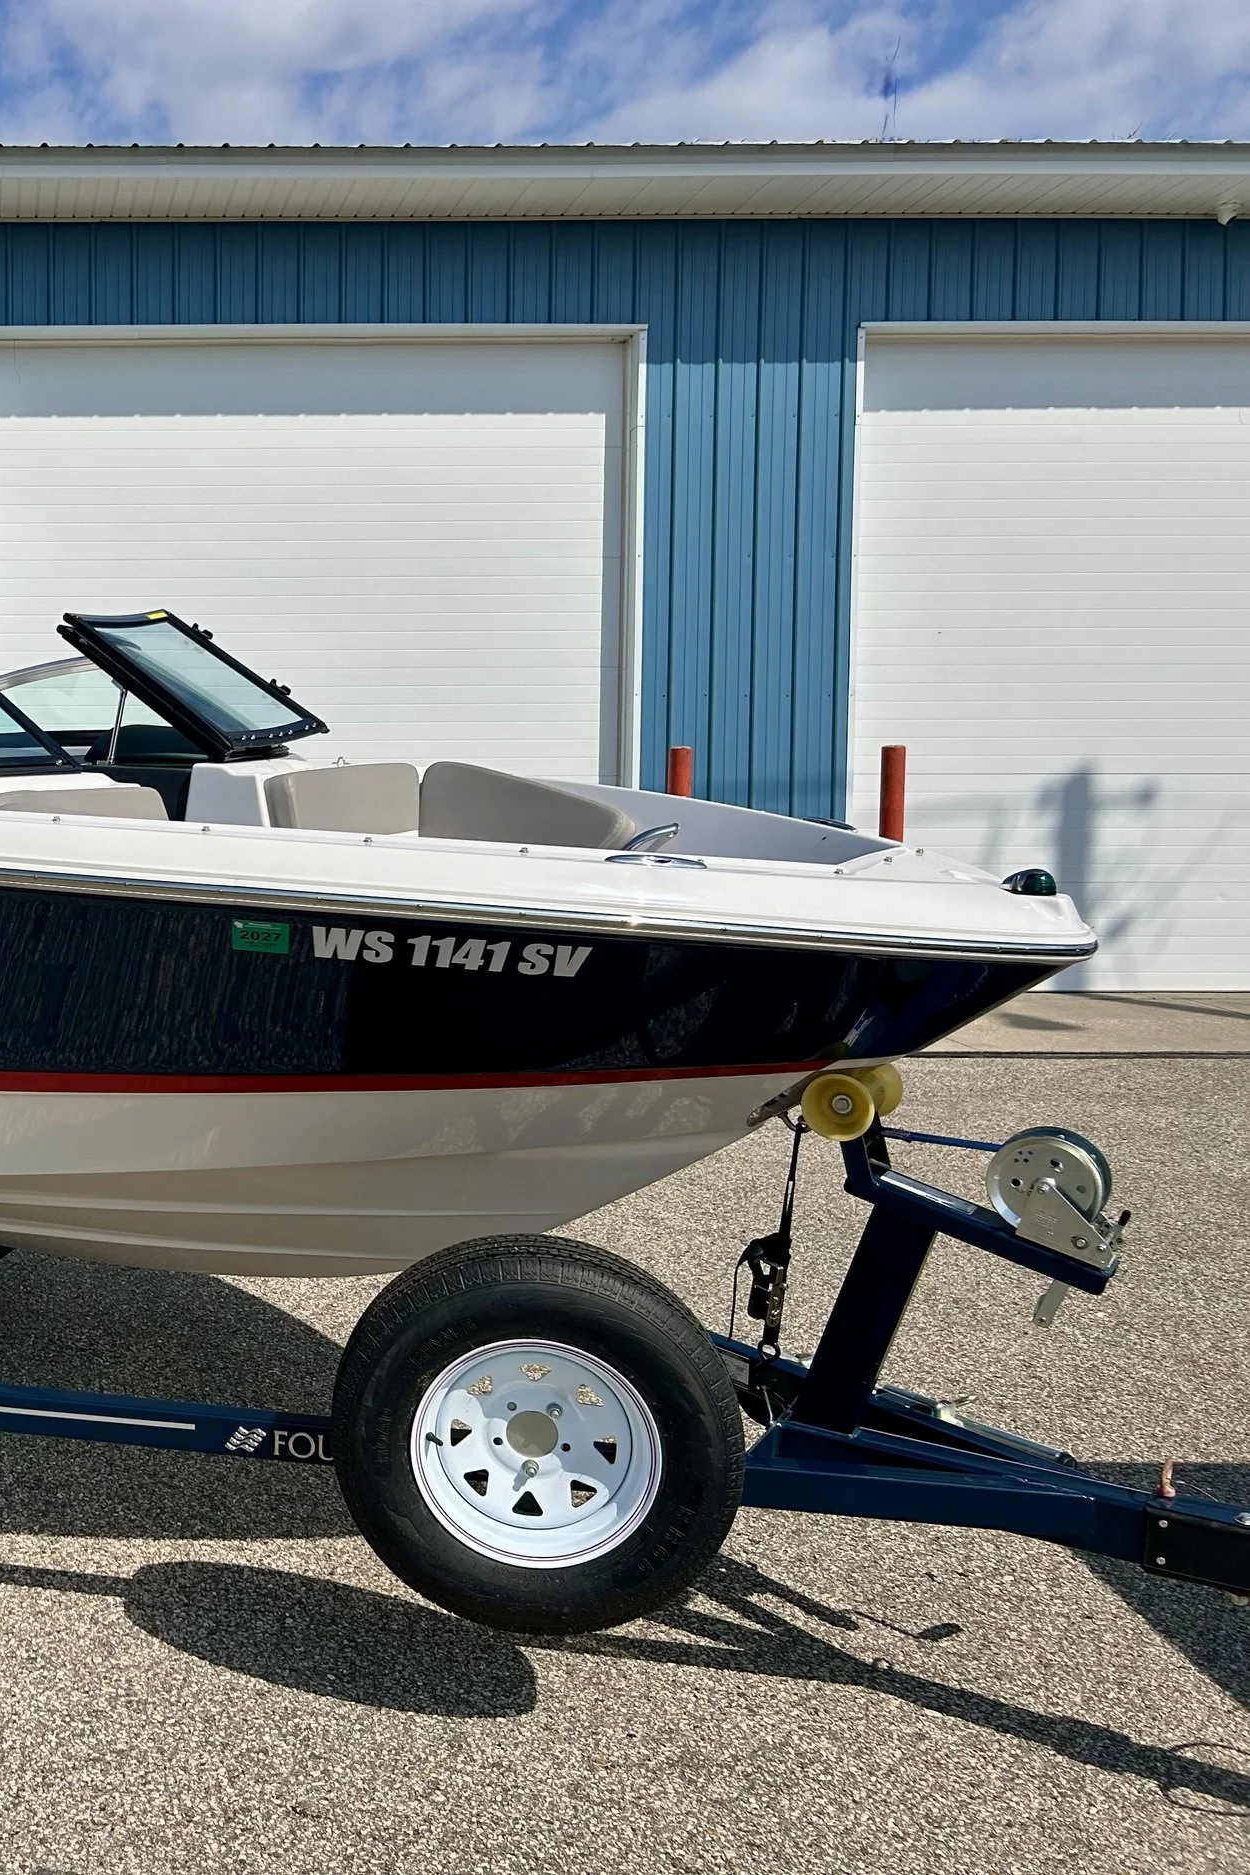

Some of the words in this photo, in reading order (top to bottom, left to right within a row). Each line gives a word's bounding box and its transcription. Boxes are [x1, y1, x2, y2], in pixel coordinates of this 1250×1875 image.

[239, 929, 283, 942] 2027
[312, 925, 395, 963] WS
[407, 935, 512, 972] 1141
[517, 943, 593, 977] SV
[374, 1407, 392, 1463] ROAD
